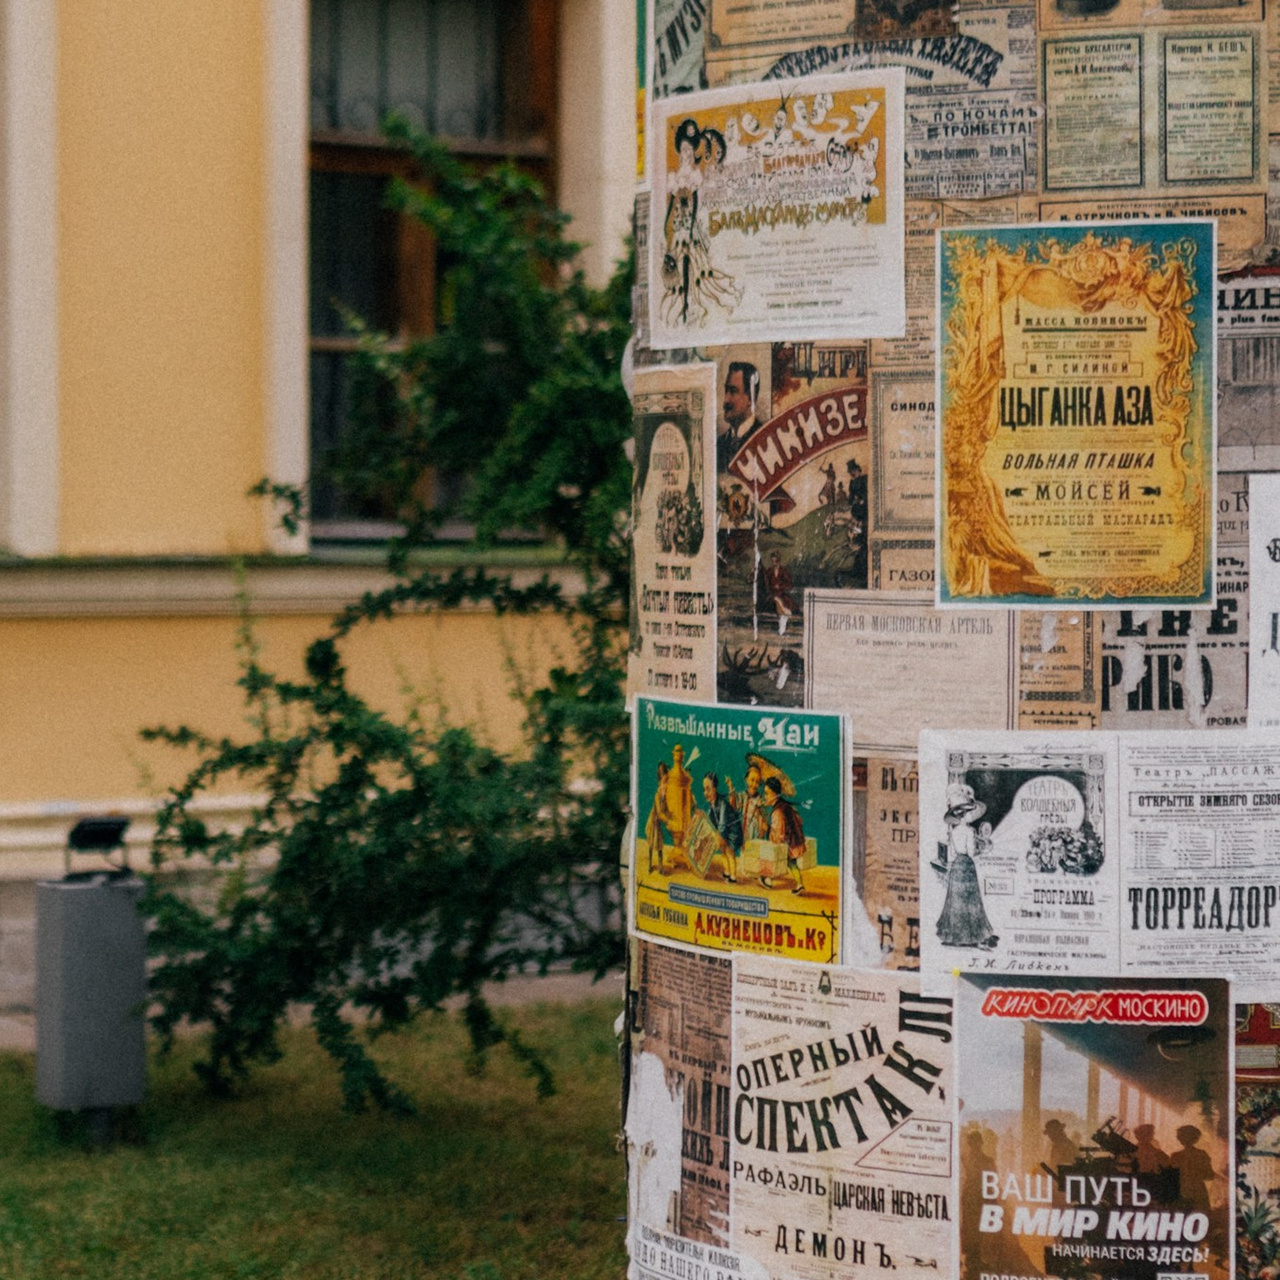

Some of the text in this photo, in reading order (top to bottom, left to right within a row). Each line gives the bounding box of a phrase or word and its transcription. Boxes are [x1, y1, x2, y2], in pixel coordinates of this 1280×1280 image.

[934, 107, 1038, 122] ПО НОЧАМЪ
[1075, 211, 1150, 221] СТРУЧКОВЪ
[1180, 207, 1247, 218] ЧИБИСОВЪ
[1063, 363, 1128, 374] СИЛИНОЙ
[1000, 385, 1154, 431] ЦЫГАНКА АЗА
[737, 393, 867, 484] ЧИНИЗЕ
[1002, 452, 1156, 470] ВОЛЬНАЯ ПТАШКА
[1036, 480, 1130, 500] МОЙСЕЙ
[826, 613, 865, 631] ПЕРВАЯ
[872, 616, 941, 634] МОСКОВСКАЯ
[1133, 765, 1280, 778] Театръ „ПАССАЖ
[1138, 795, 1194, 807] ОТКРЫТІЕ
[1200, 794, 1248, 806] ЗИМНЯГО
[880, 810, 913, 823] ЭКС
[892, 828, 919, 843] ПР
[1033, 889, 1095, 905] ПРОГРАММА
[1128, 885, 1280, 932] ТОРРЕАДОР
[986, 993, 1200, 1018] КИНОПАРК МОСКИНО
[737, 1023, 885, 1092] ОПЕРНЫЙ
[733, 1161, 827, 1196] РАФАЭЛЬ
[834, 1181, 885, 1213] ЦАРСКАЯ
[981, 1171, 1151, 1207] ВАШ ПУТЬ
[979, 1204, 1209, 1242] В МИР КИНО
[774, 1224, 897, 1270] ДЕМОНЪ.
[1052, 1244, 1210, 1265] НАЧИНАЕТСЯ ЗДЕСЬ!
